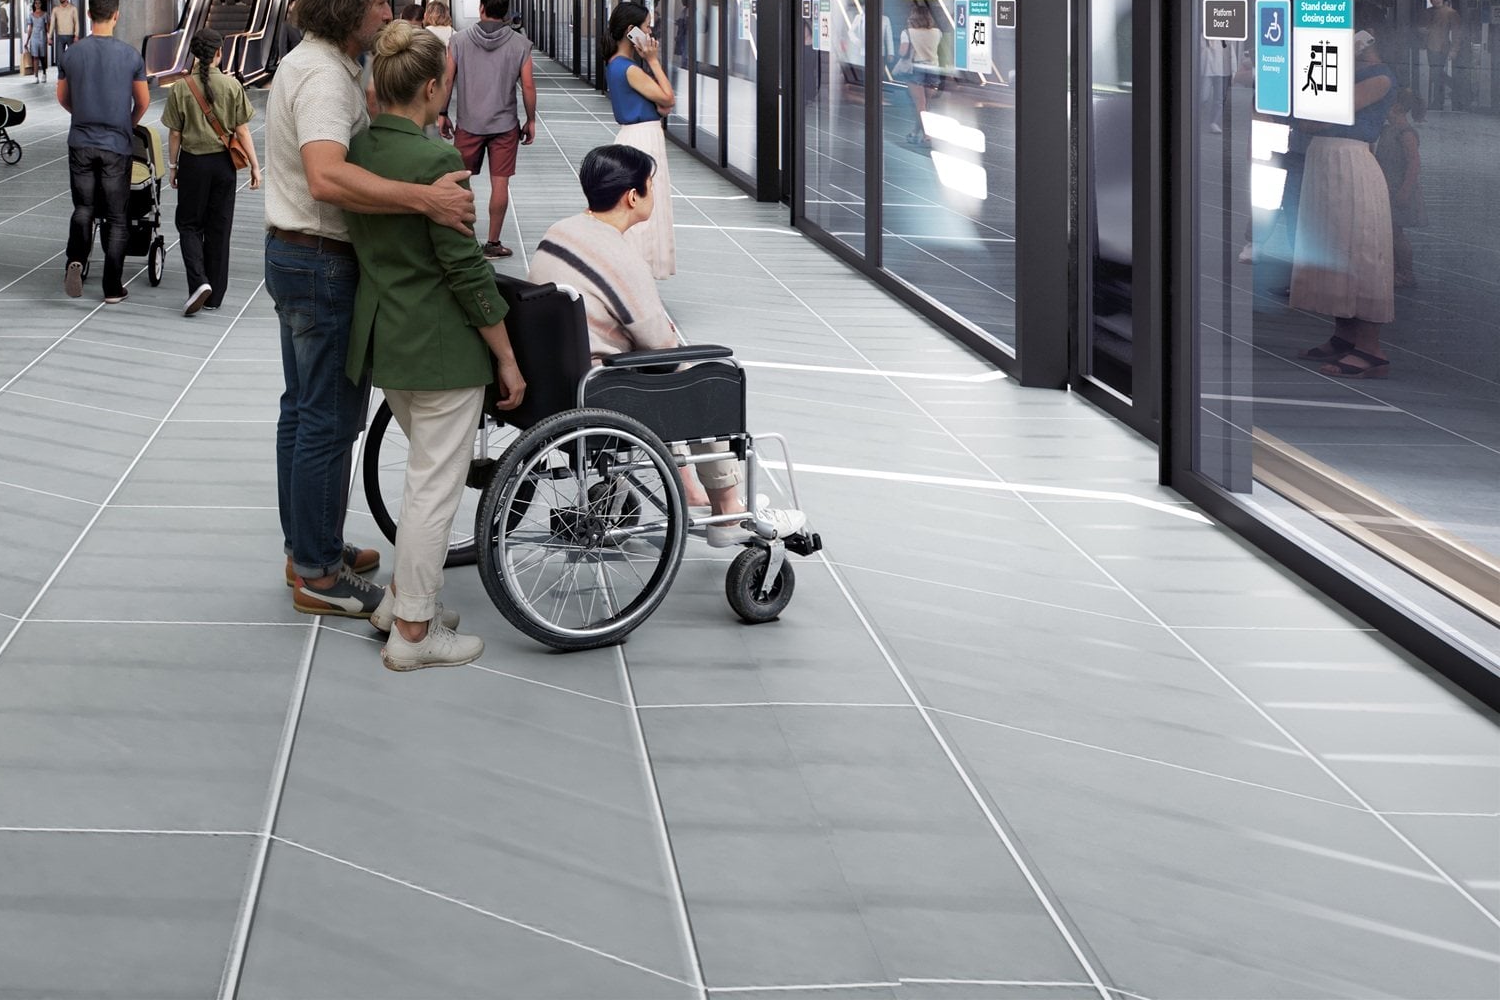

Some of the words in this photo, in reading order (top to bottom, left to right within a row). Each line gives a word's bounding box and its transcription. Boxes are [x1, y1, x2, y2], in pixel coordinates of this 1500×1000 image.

[1301, 2, 1320, 11] Stand
[1321, 2, 1337, 11] clear
[1338, 2, 1346, 11] of
[1213, 8, 1232, 16] Platform
[1232, 8, 1236, 16] 1
[1213, 19, 1225, 28] Door
[1225, 19, 1229, 28] 2
[1302, 14, 1325, 25] closing
[1325, 14, 1345, 23] doors
[1262, 55, 1285, 63] Accessible
[1262, 65, 1280, 74] doorway
